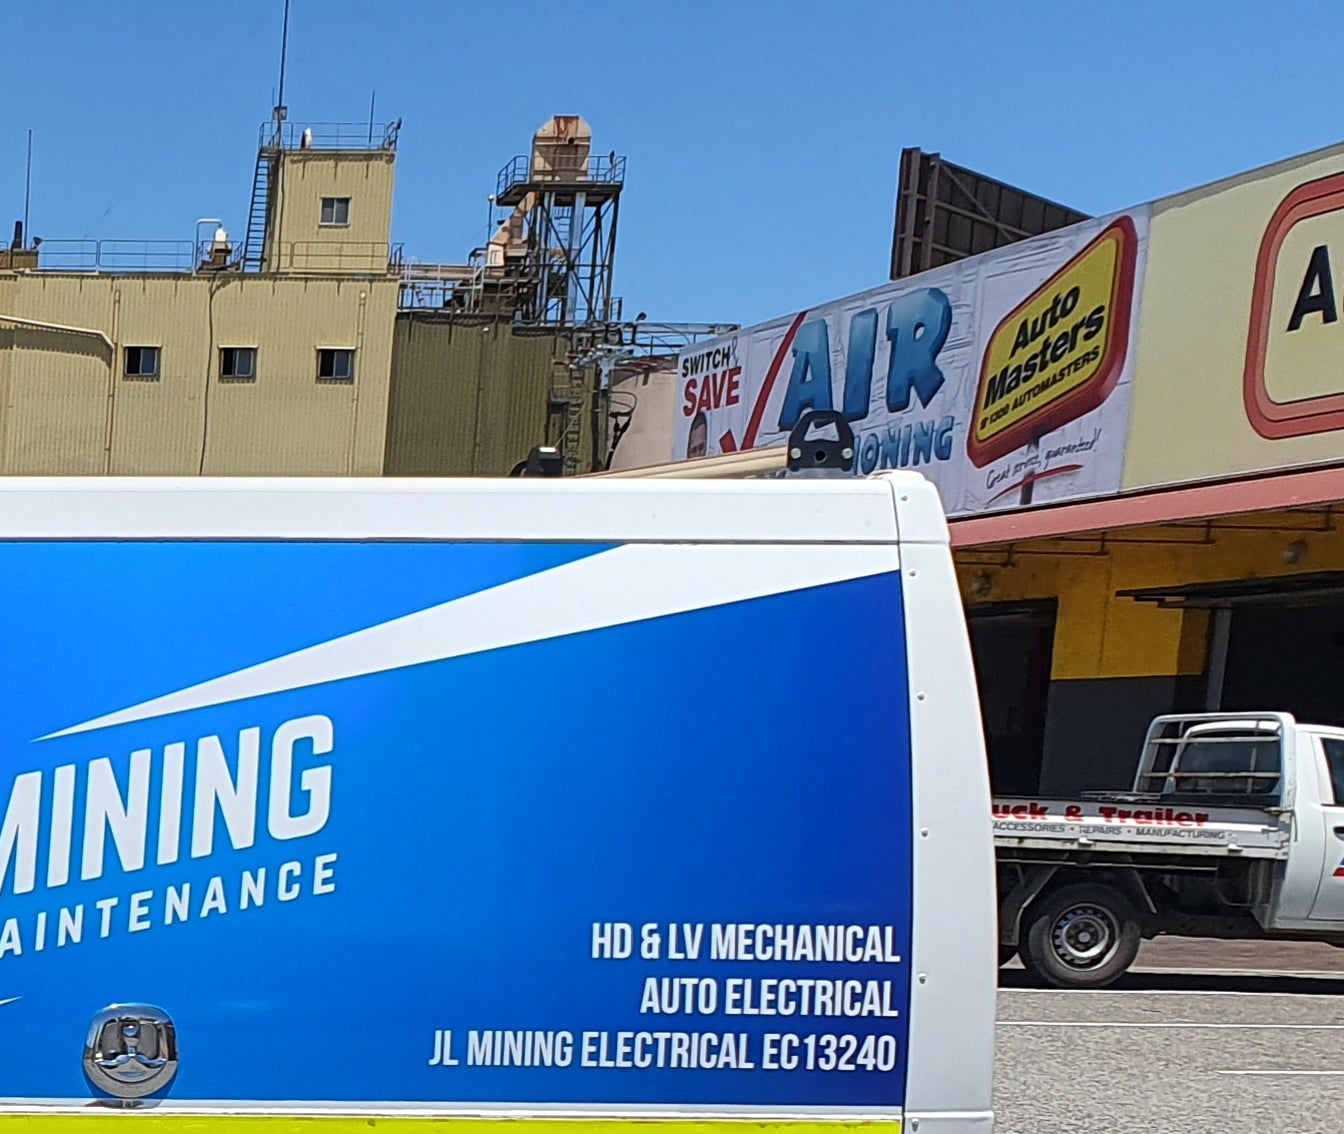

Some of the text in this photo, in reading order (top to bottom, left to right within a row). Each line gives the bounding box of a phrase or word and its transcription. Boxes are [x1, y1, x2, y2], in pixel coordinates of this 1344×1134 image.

[1286, 245, 1338, 332] A
[1009, 286, 1081, 359] Auto
[682, 345, 731, 378] SWITCH
[778, 287, 953, 432] AIR
[983, 304, 1106, 411] Masters
[1011, 345, 1101, 411] AUTOMASTERS
[683, 365, 742, 417] SAVE
[852, 415, 955, 476] IONING
[992, 802, 1209, 827] uck & Trailer
[993, 821, 1226, 841] ACCESSORIES REPAIRS MANUFACTURING
[592, 922, 901, 962] HD & LV MECHANICAL
[640, 977, 899, 1017] AUTO ELECTRICAL
[428, 1029, 459, 1066] JL
[466, 1030, 573, 1067] MINING
[580, 1031, 755, 1069] ELECTRICAL
